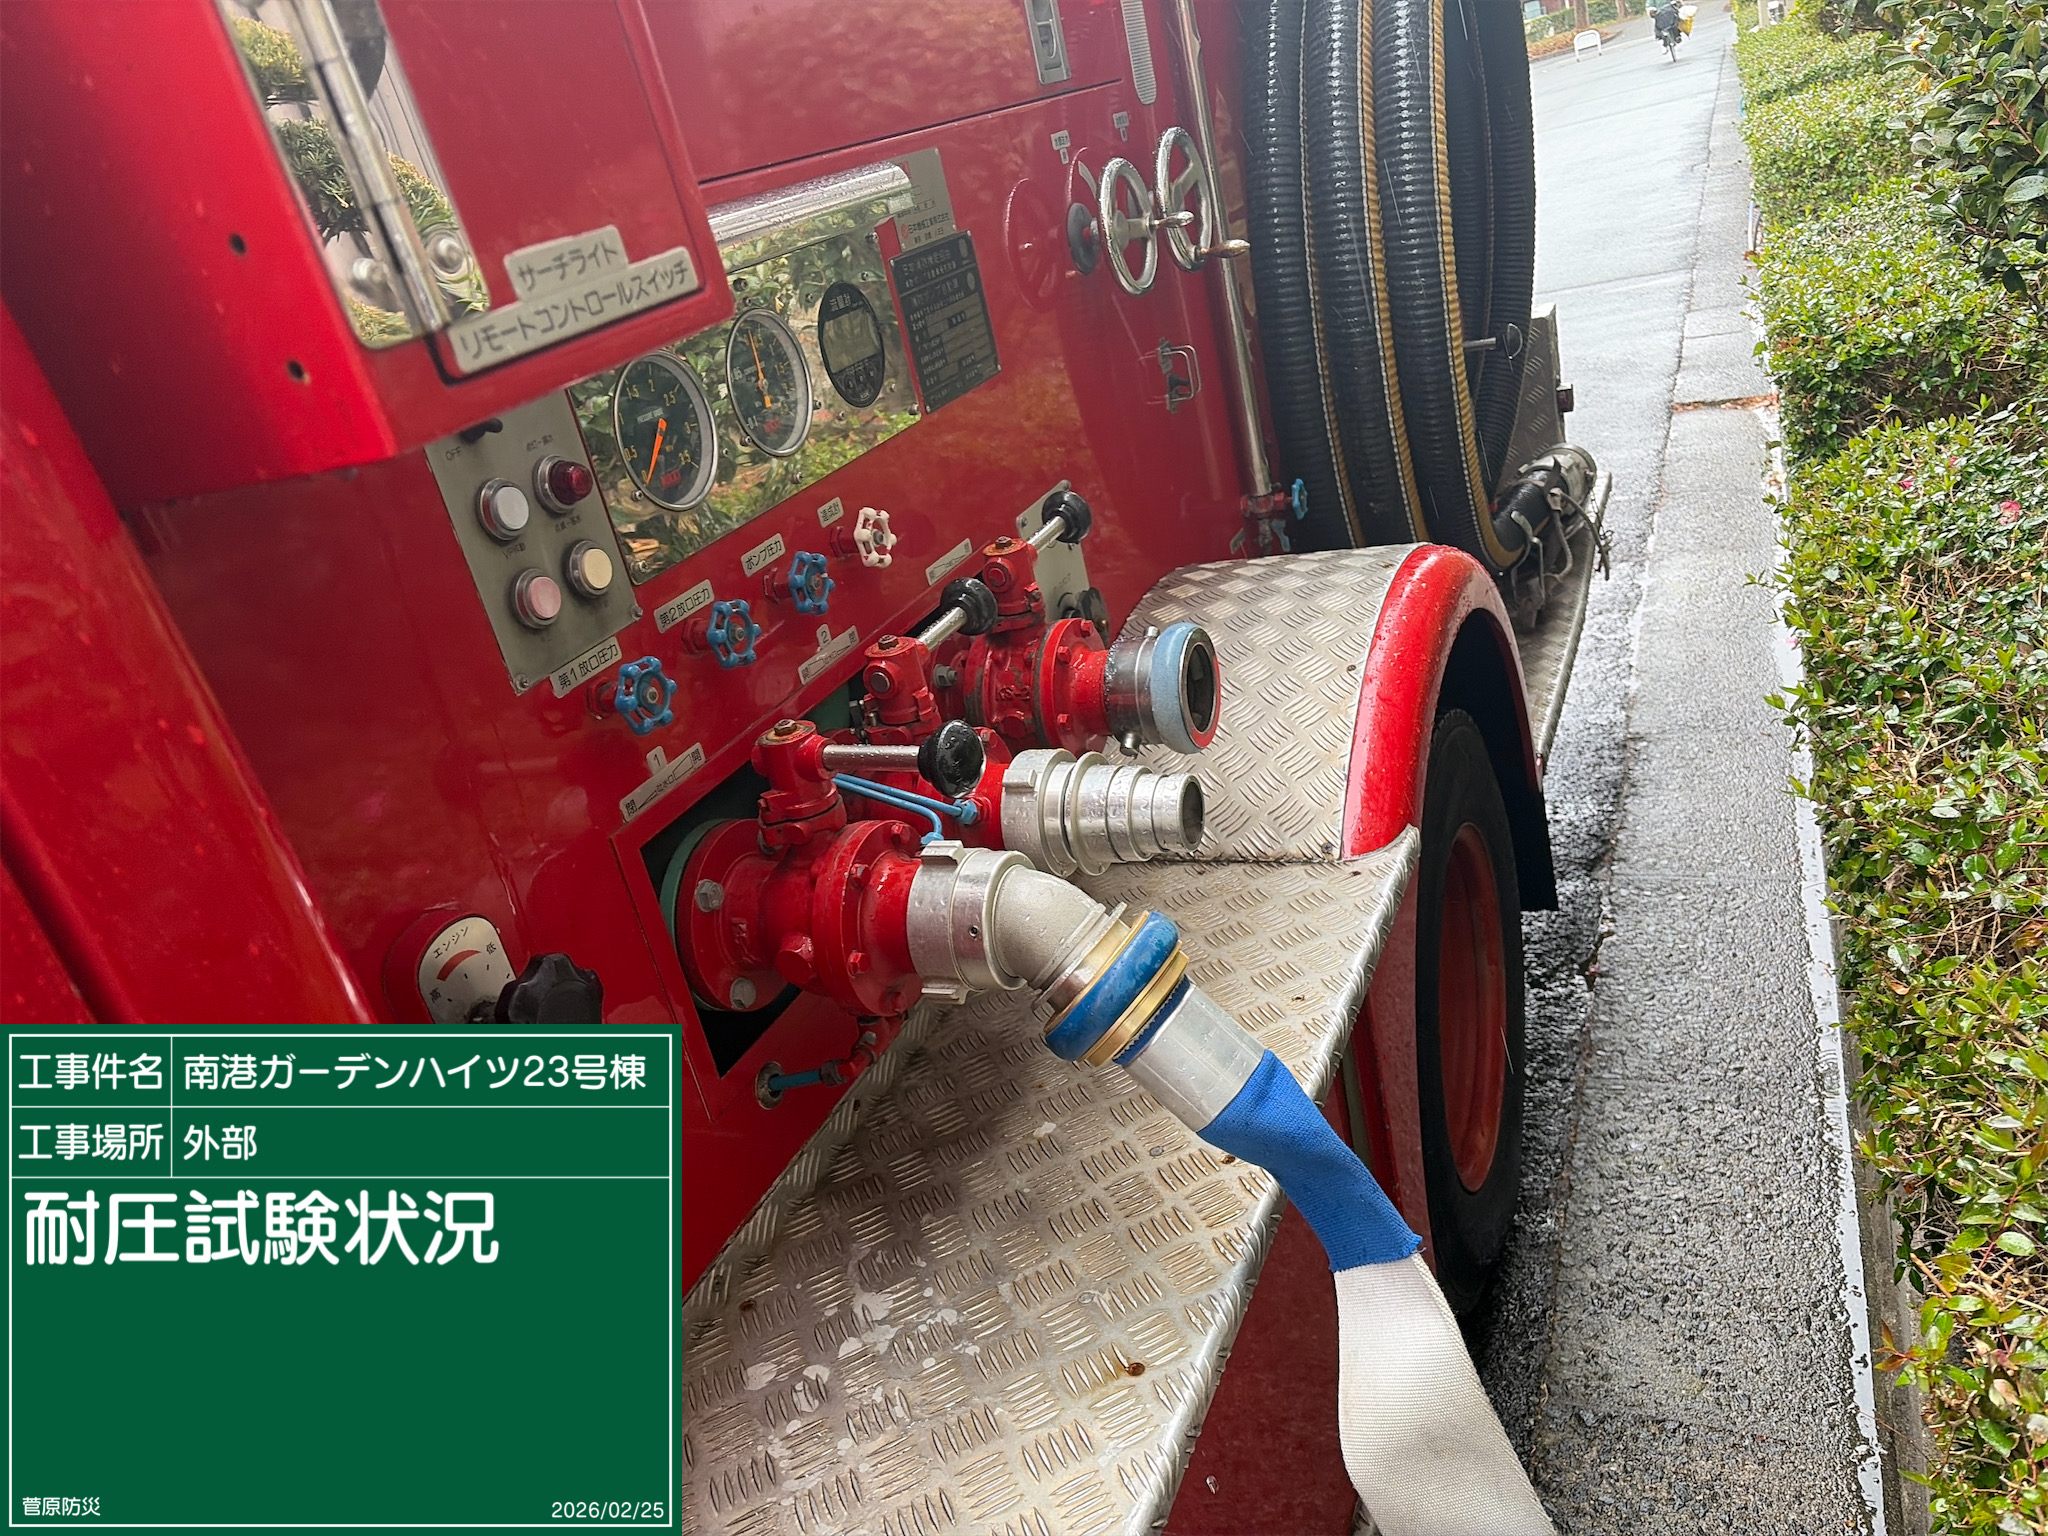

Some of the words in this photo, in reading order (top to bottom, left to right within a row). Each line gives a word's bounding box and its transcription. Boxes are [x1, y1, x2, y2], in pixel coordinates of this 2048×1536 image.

[518, 241, 617, 292] サーチライト
[460, 259, 689, 360] リモートコントロールスイッチ
[626, 384, 639, 400] 1.5
[649, 379, 656, 392] 2
[663, 391, 676, 406] 2.5
[624, 444, 637, 461] 0.5
[745, 540, 782, 570] ポンプ圧力
[660, 588, 710, 628] 第2放口圧力
[821, 630, 830, 644] 2
[558, 644, 618, 690] 第1放口圧力
[654, 753, 661, 767] 1
[433, 926, 469, 959] エンジン
[486, 942, 497, 956] 低
